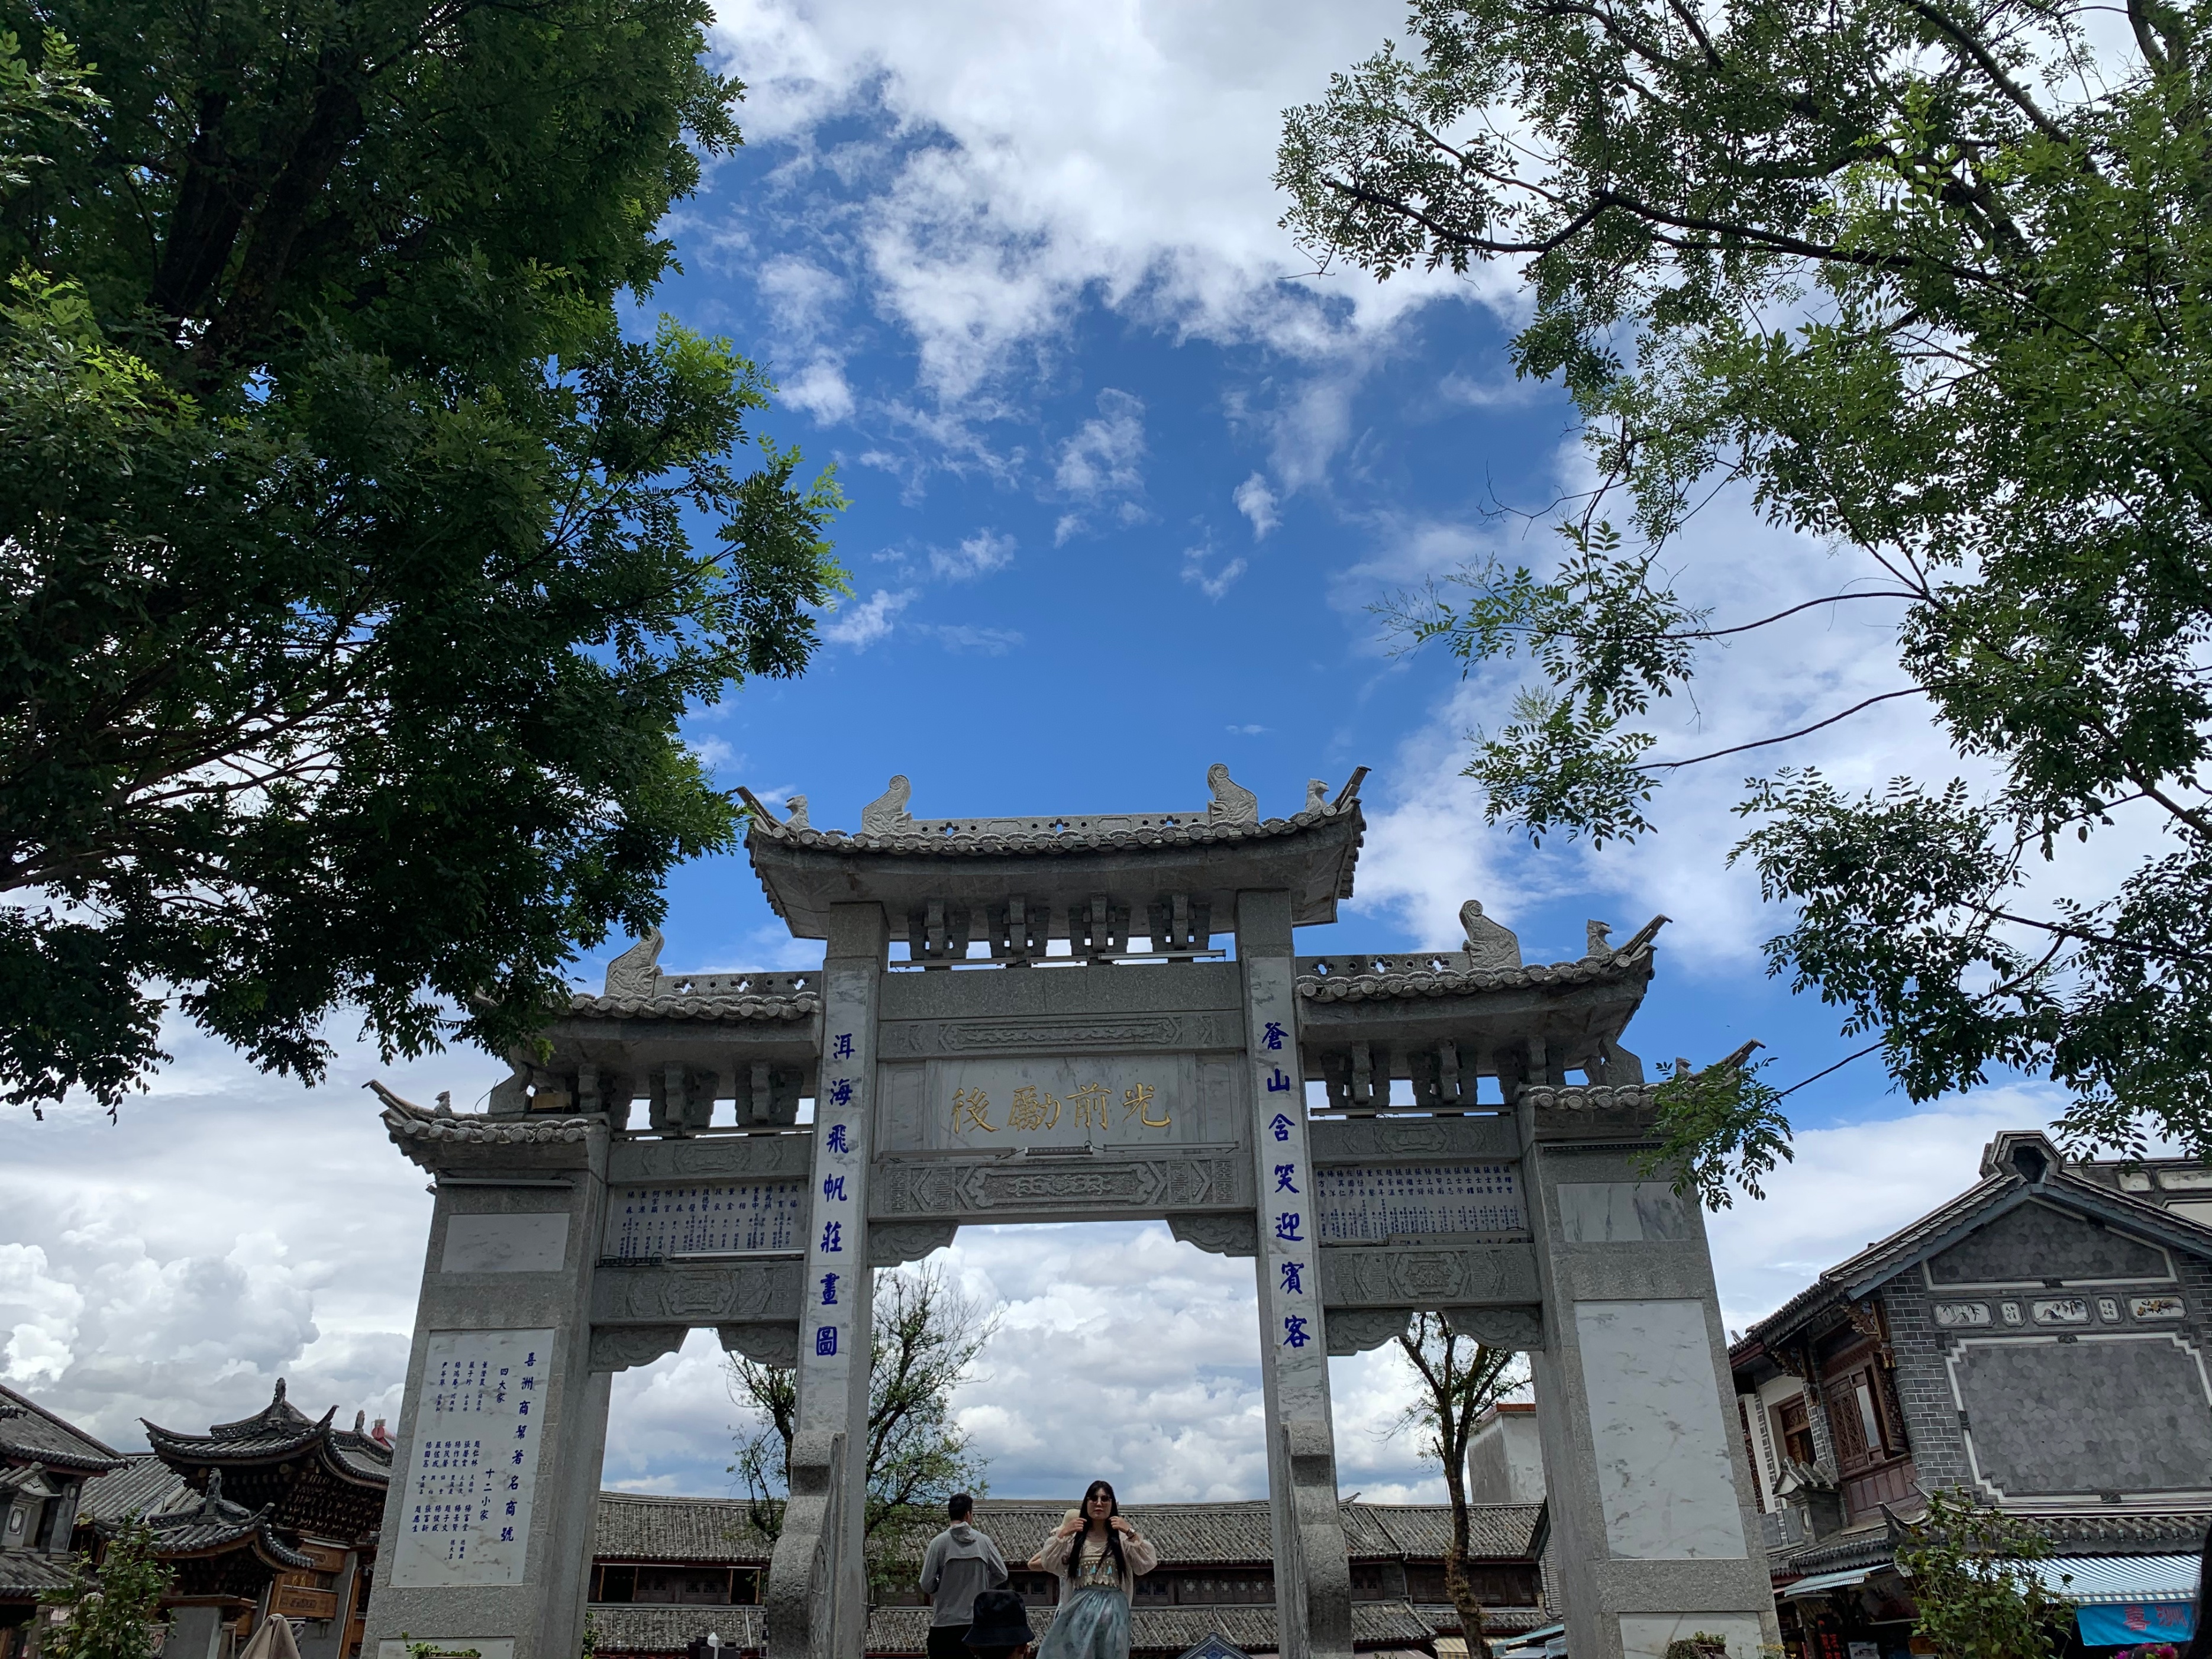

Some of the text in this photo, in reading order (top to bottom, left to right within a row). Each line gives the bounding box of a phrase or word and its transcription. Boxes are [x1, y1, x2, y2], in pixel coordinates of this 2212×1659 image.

[1261, 1021, 1311, 1348] 蒼山含笑迎賓客
[496, 1367, 509, 1403] 四大家
[480, 1468, 495, 1521] 十二小家
